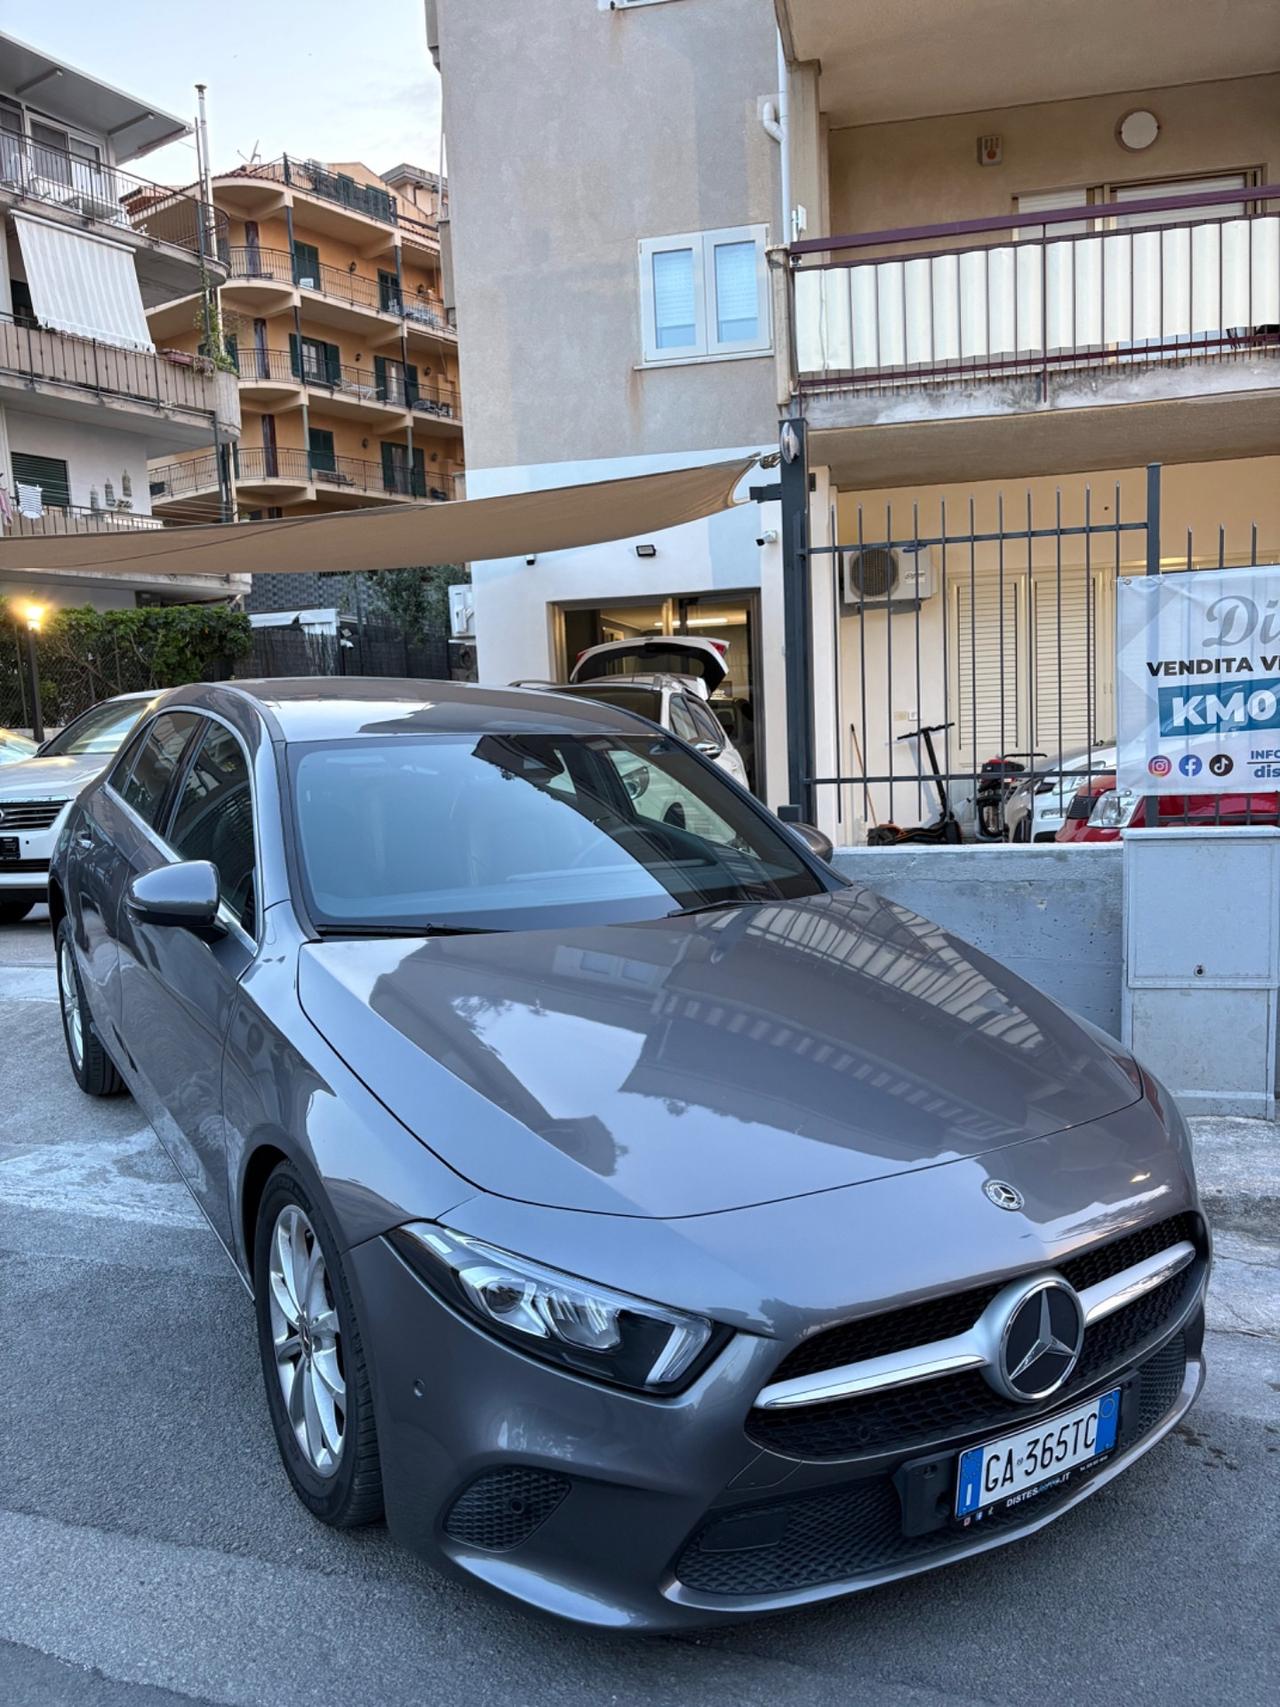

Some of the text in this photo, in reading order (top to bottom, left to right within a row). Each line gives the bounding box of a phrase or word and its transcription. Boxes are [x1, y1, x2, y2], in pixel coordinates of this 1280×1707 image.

[1202, 595, 1280, 648] Di
[1146, 655, 1280, 677] VENDITA V
